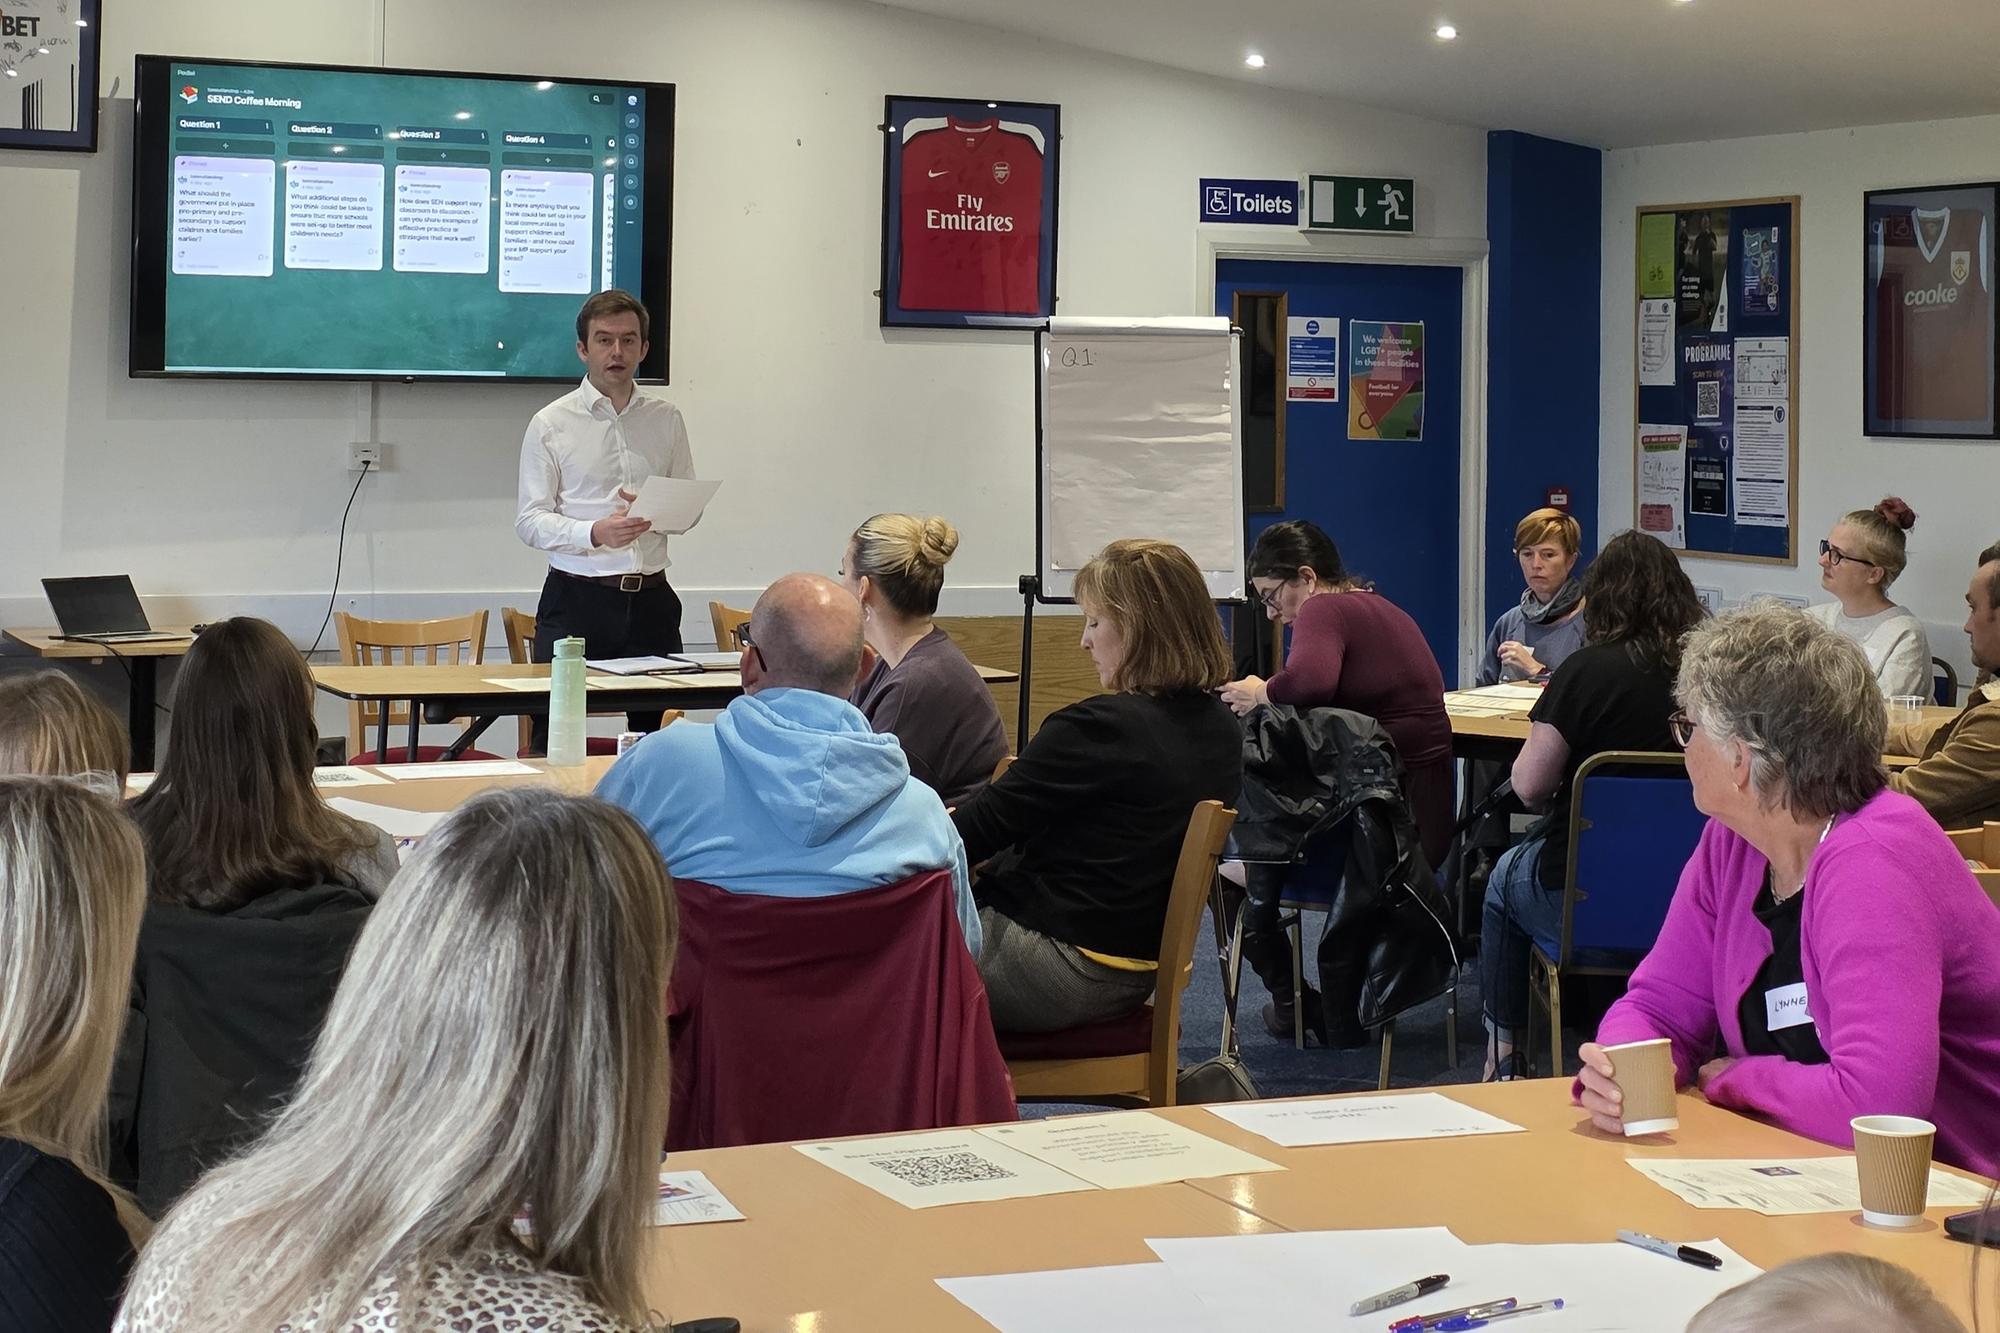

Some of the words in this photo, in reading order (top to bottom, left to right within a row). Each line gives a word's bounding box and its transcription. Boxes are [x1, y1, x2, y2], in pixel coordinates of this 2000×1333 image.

[207, 94, 233, 105] SEND
[234, 96, 264, 106] Coffee
[265, 98, 302, 110] Morning
[179, 120, 214, 129] Question
[216, 121, 221, 129] 1
[291, 124, 325, 134] Question
[326, 125, 333, 134] 2
[400, 130, 432, 140] Question
[505, 134, 538, 144] Question
[538, 136, 545, 144] 4
[957, 194, 983, 212] Fly
[1232, 193, 1293, 214] Toilets
[926, 209, 1014, 232] Emirates
[1904, 283, 1958, 306] cooke
[1362, 335, 1376, 344] We
[1377, 336, 1412, 345] welcome
[1360, 346, 1385, 355] LGBT+
[1387, 348, 1414, 358] people
[1685, 344, 1731, 363] PROGRAMME
[1364, 358, 1386, 367] these
